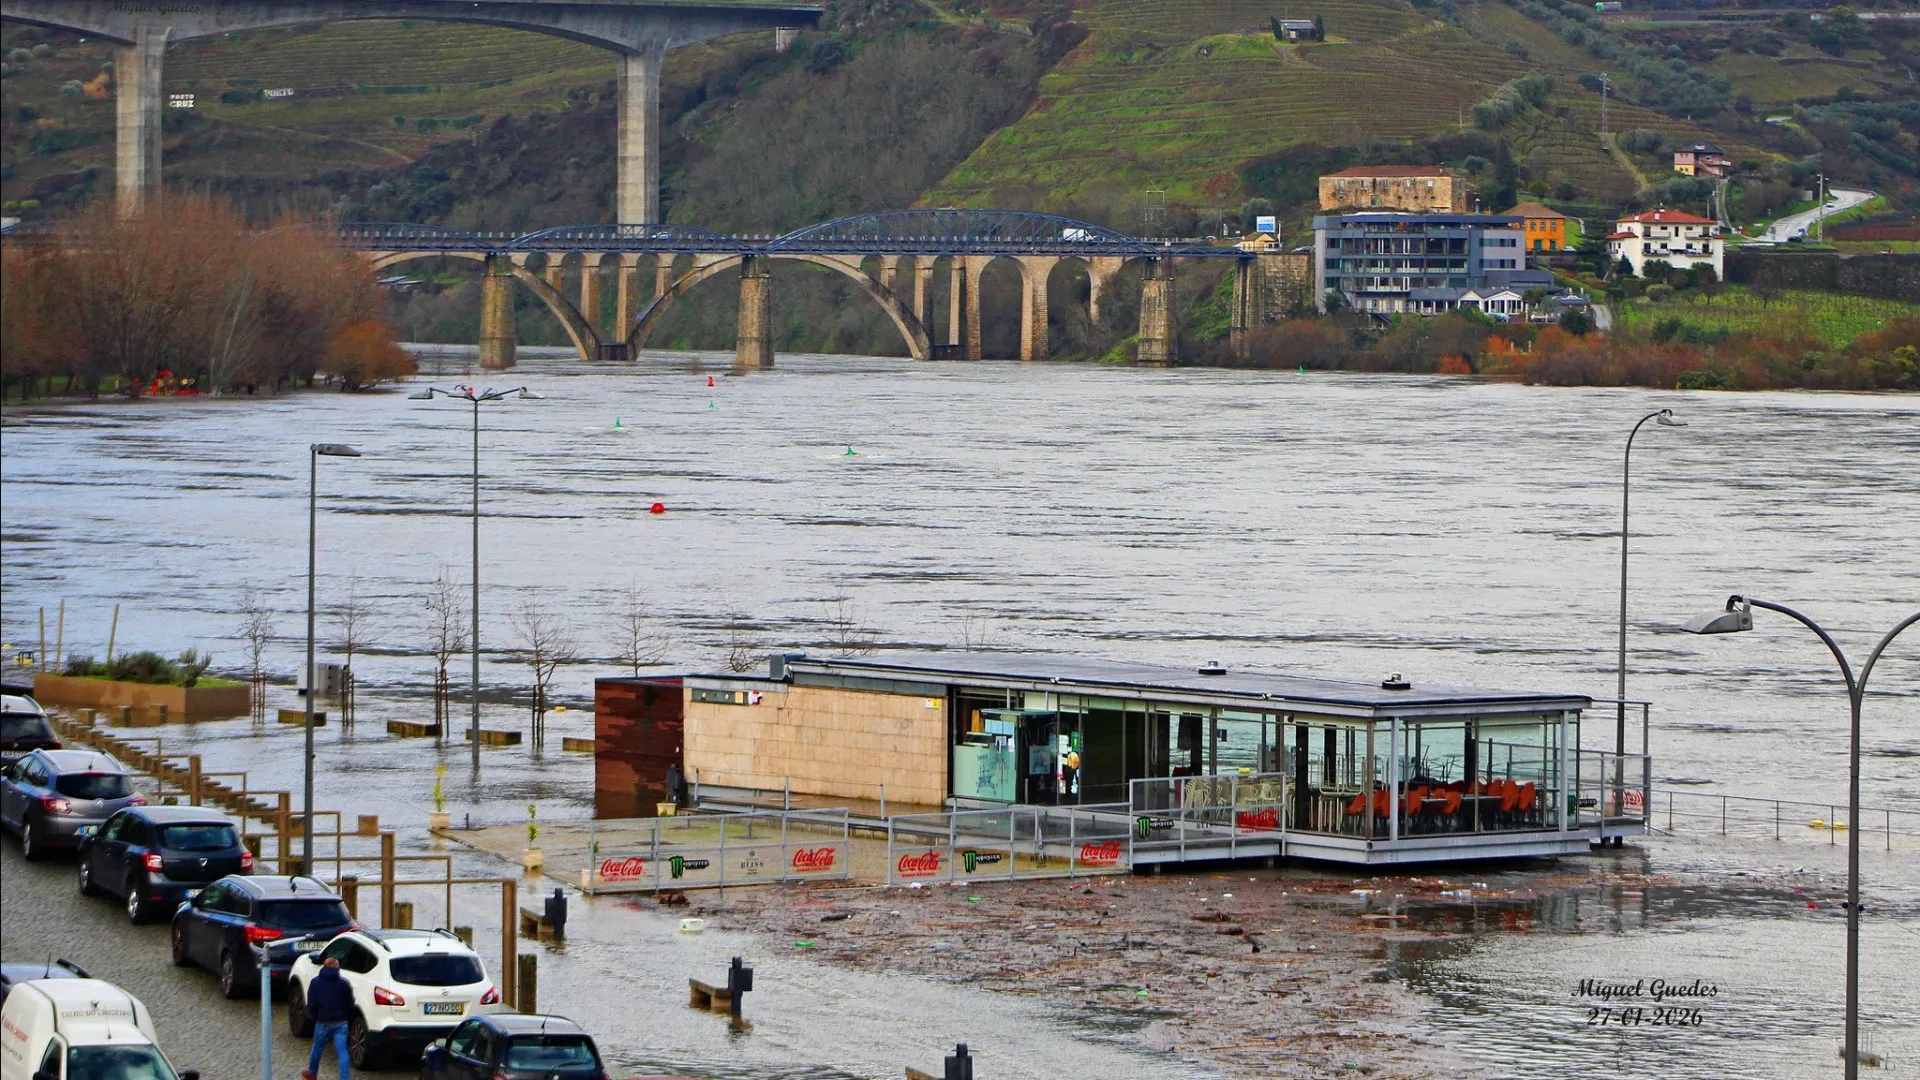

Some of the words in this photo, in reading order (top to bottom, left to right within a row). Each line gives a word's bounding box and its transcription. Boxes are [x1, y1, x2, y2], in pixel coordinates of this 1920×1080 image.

[169, 100, 195, 108] CRUZ
[792, 847, 836, 867] Coca-Cola
[1081, 841, 1122, 860] Coca-Cola
[600, 857, 646, 877] Coca-Cola
[898, 852, 941, 872] Coca-Cola
